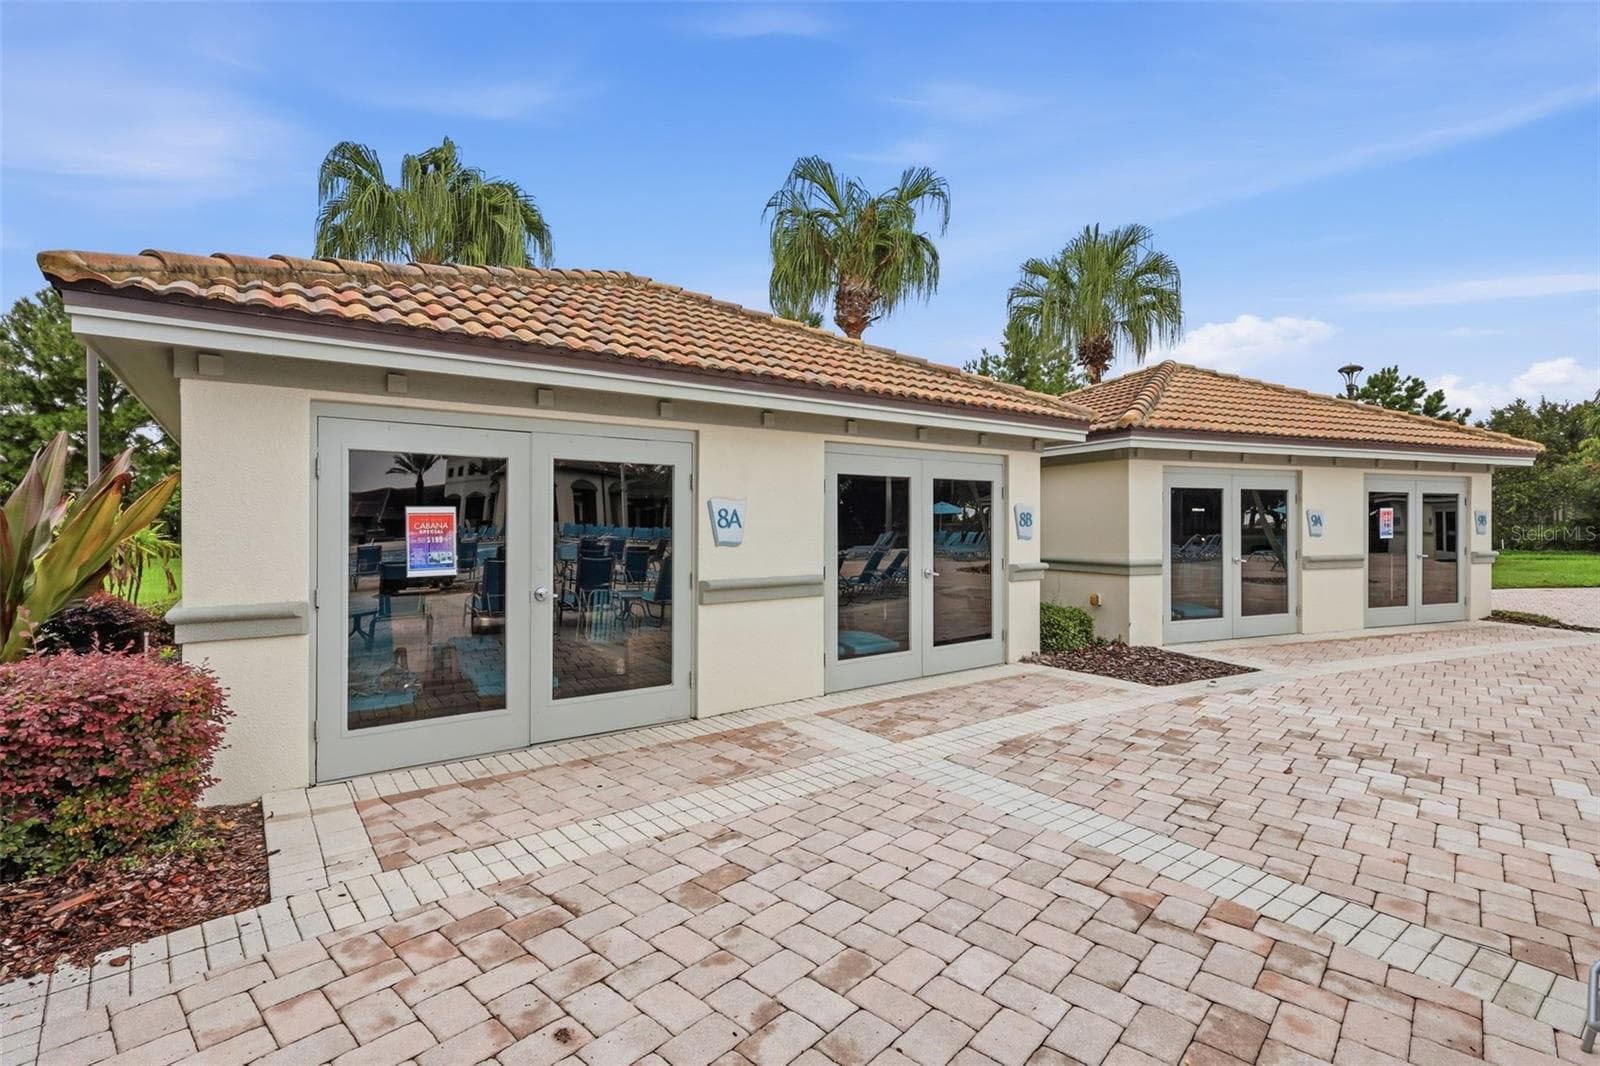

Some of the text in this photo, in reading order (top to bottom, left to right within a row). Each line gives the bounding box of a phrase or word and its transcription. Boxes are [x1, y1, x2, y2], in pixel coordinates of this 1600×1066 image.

[717, 508, 742, 528] 8A
[1019, 512, 1032, 527] 8B
[1311, 514, 1322, 527] 9A
[413, 522, 448, 530] CABANA
